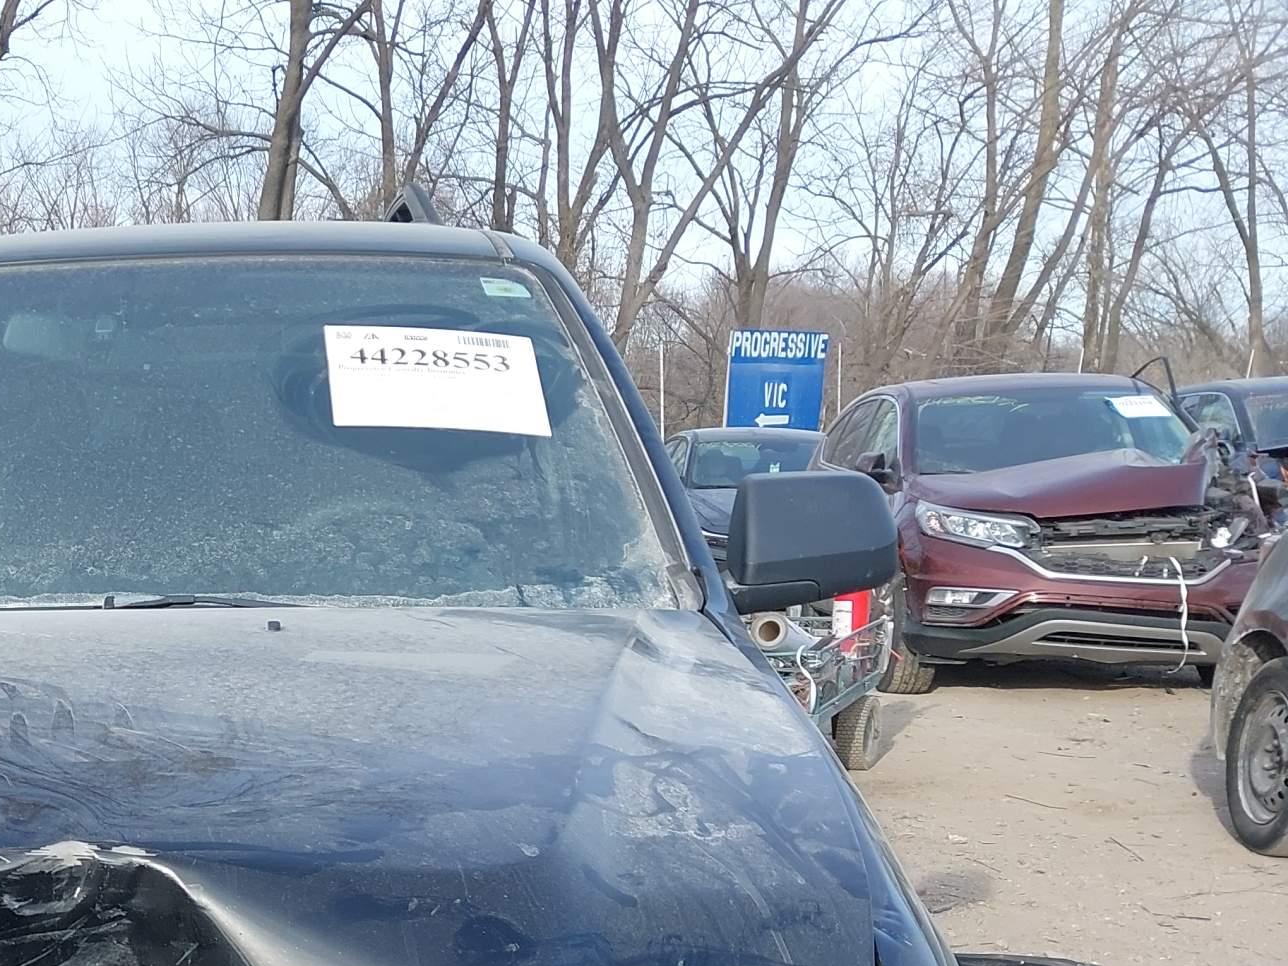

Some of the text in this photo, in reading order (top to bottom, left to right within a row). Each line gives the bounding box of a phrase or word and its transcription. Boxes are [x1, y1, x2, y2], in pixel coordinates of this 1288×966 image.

[732, 331, 828, 359] PROGRESSIVE
[350, 346, 511, 373] 44228553
[764, 381, 788, 408] VIC
